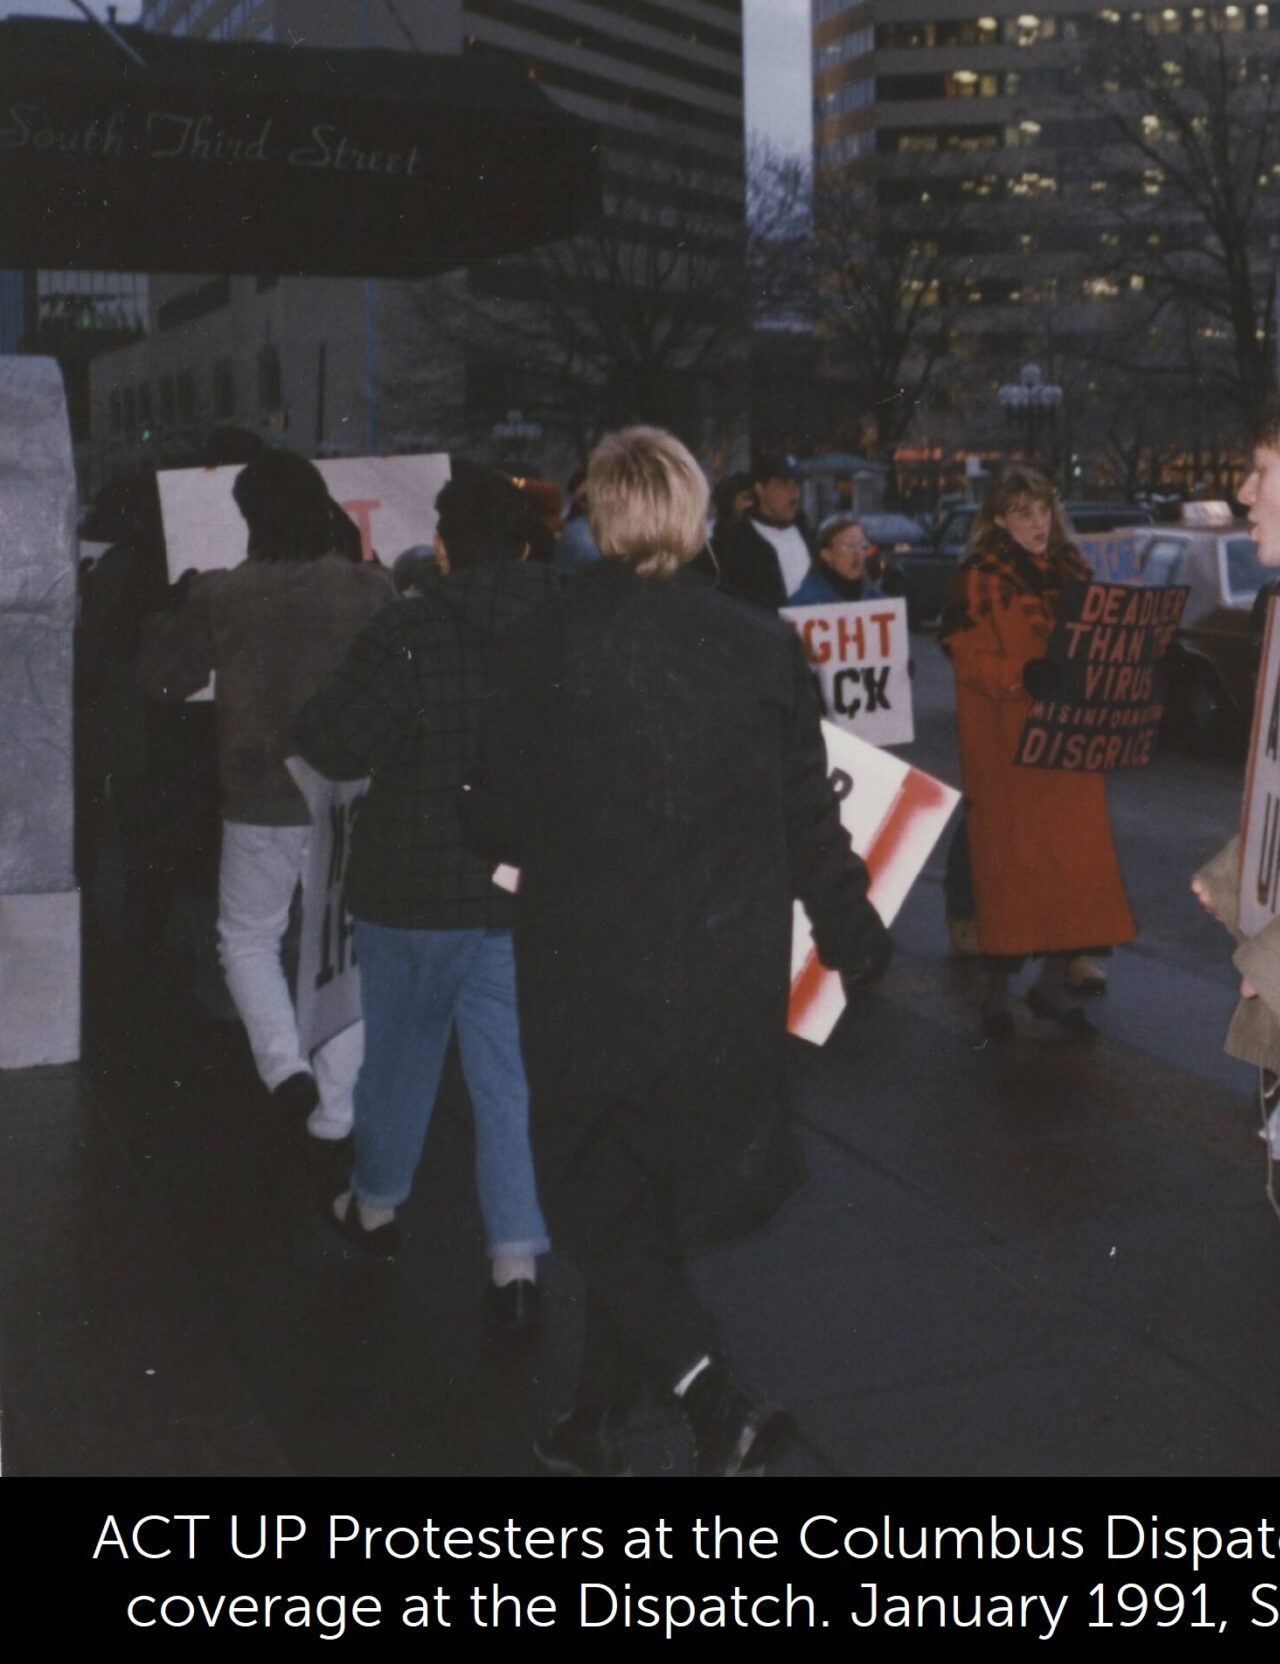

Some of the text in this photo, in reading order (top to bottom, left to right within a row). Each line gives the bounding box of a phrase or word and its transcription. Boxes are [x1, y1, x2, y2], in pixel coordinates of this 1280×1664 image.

[0, 104, 423, 178] South Third Street
[789, 613, 895, 665] GHT
[1066, 621, 1145, 663] THAN
[1084, 664, 1154, 701] VIRUS
[1021, 726, 1156, 770] DISGRACE
